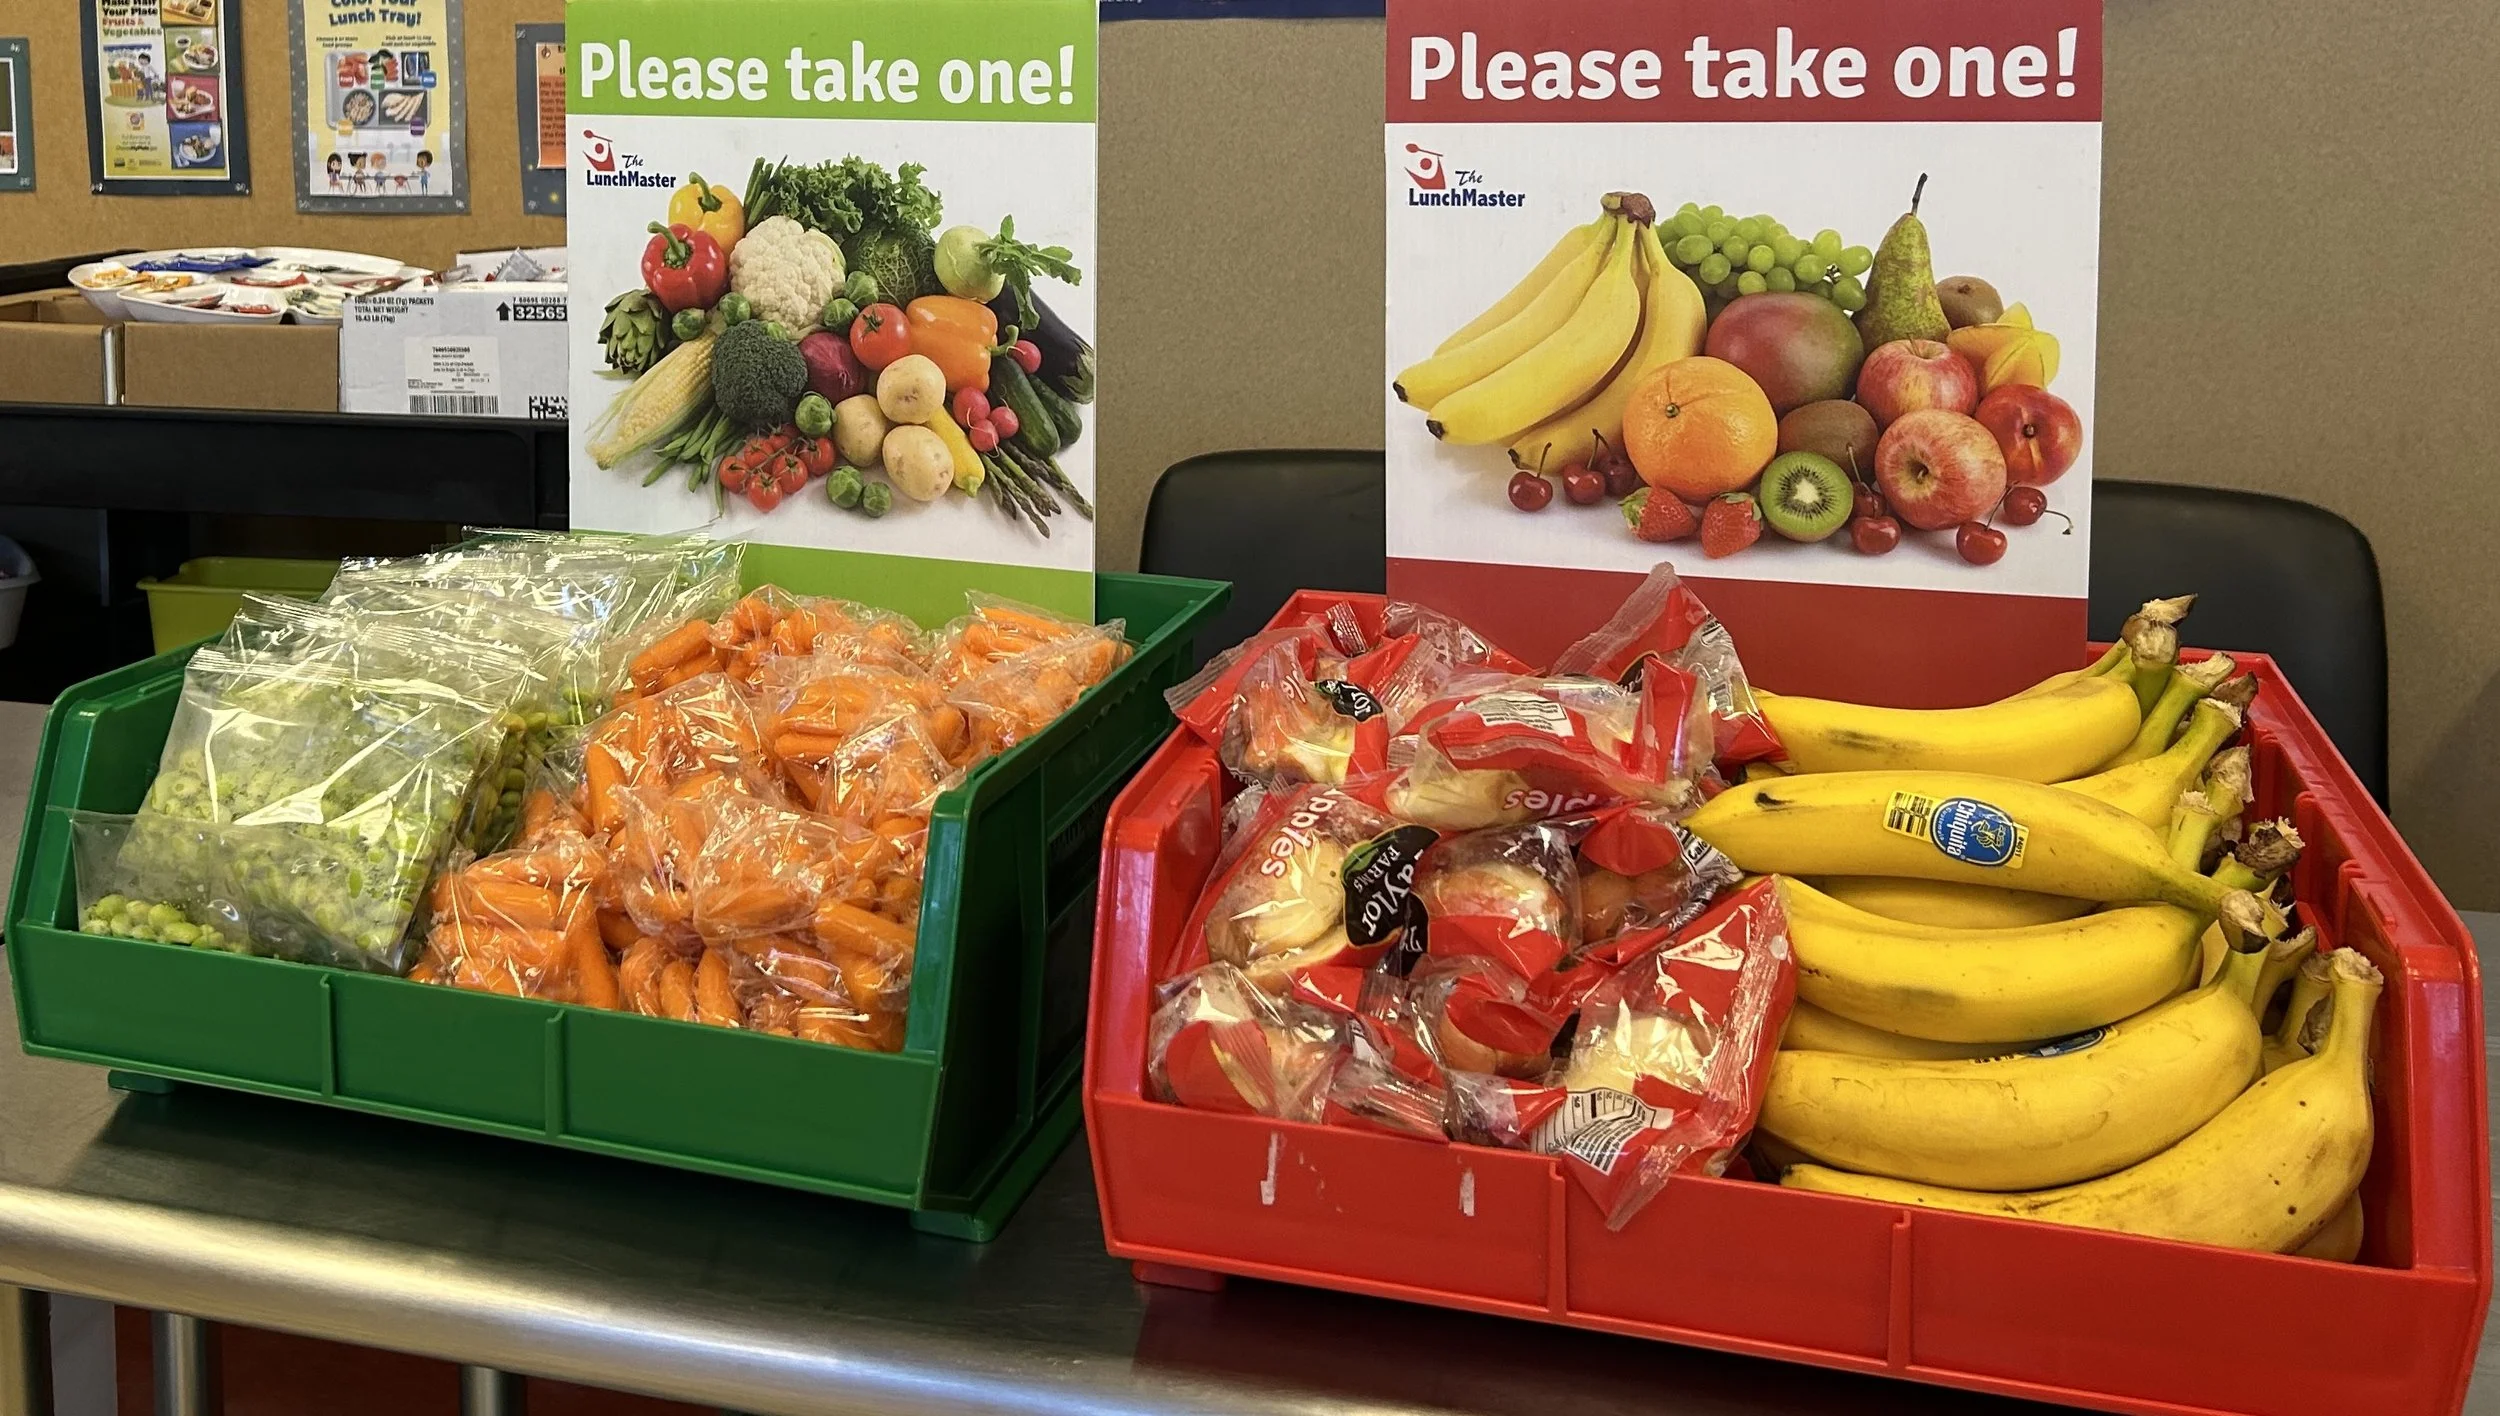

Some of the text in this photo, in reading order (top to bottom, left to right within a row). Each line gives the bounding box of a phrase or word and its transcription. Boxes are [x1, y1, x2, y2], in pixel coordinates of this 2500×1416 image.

[103, 7, 158, 16] Your Plate
[329, 7, 421, 27] Lunch Tray!
[103, 17, 136, 26] Fruits
[103, 27, 162, 37] Vegetables
[580, 39, 1074, 104] Please take one!
[1411, 27, 2078, 100] Please take one!
[621, 154, 644, 169] The
[586, 169, 677, 188] LunchMaster
[1455, 170, 1483, 186] The
[1409, 188, 1526, 207] LunchMaster
[408, 297, 434, 305] PACKETS
[516, 306, 565, 319] 32565
[1946, 800, 1977, 856] Chiquita
[1353, 844, 1400, 894] FARMS
